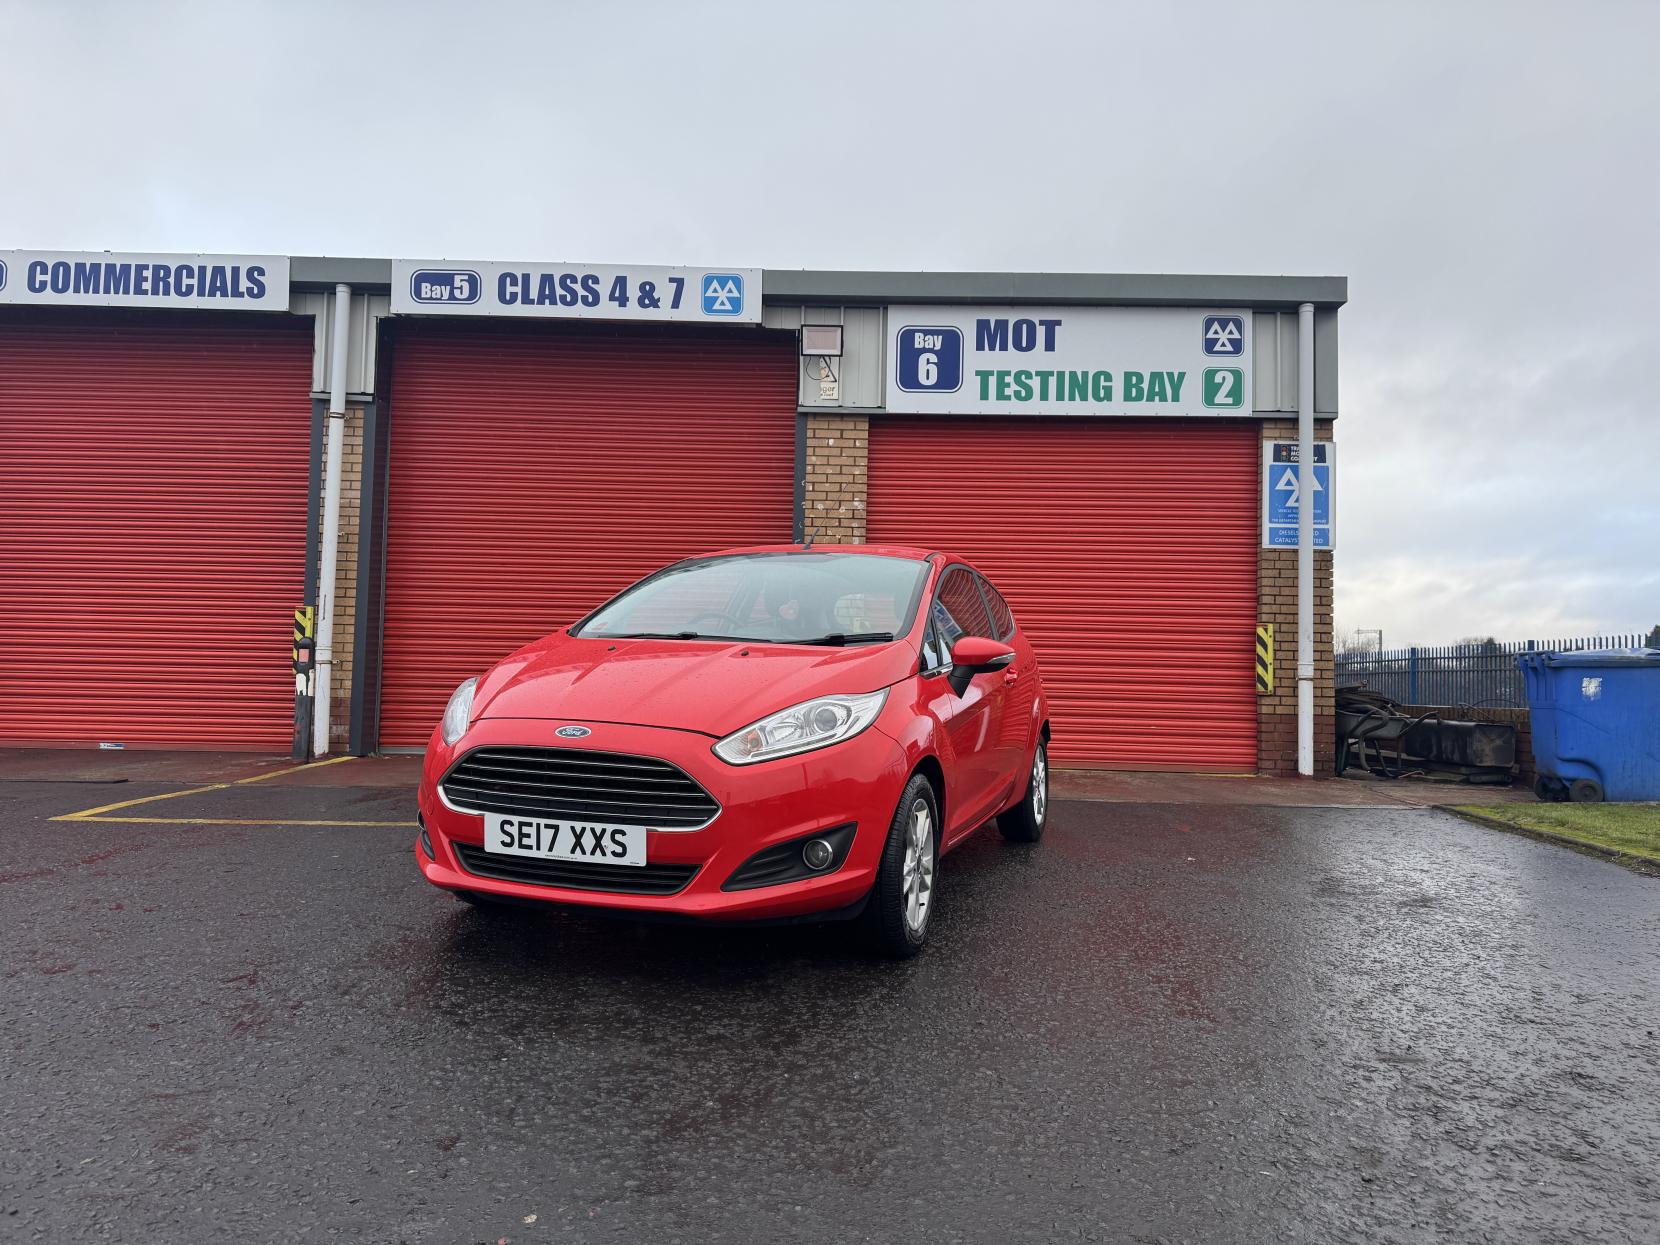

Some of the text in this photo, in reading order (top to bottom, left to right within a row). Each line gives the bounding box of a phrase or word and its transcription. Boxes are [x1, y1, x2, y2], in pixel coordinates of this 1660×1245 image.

[27, 261, 266, 299] COMMERCIALS
[421, 274, 470, 301] Bay 5
[498, 272, 685, 310] CLASS 4 & 7
[914, 332, 943, 351] Bay
[975, 319, 1062, 352] MOT
[917, 353, 938, 386] 6
[975, 369, 1187, 403] TESTING BAY
[1213, 371, 1235, 404] 2
[500, 819, 628, 858] SE17 XXS
